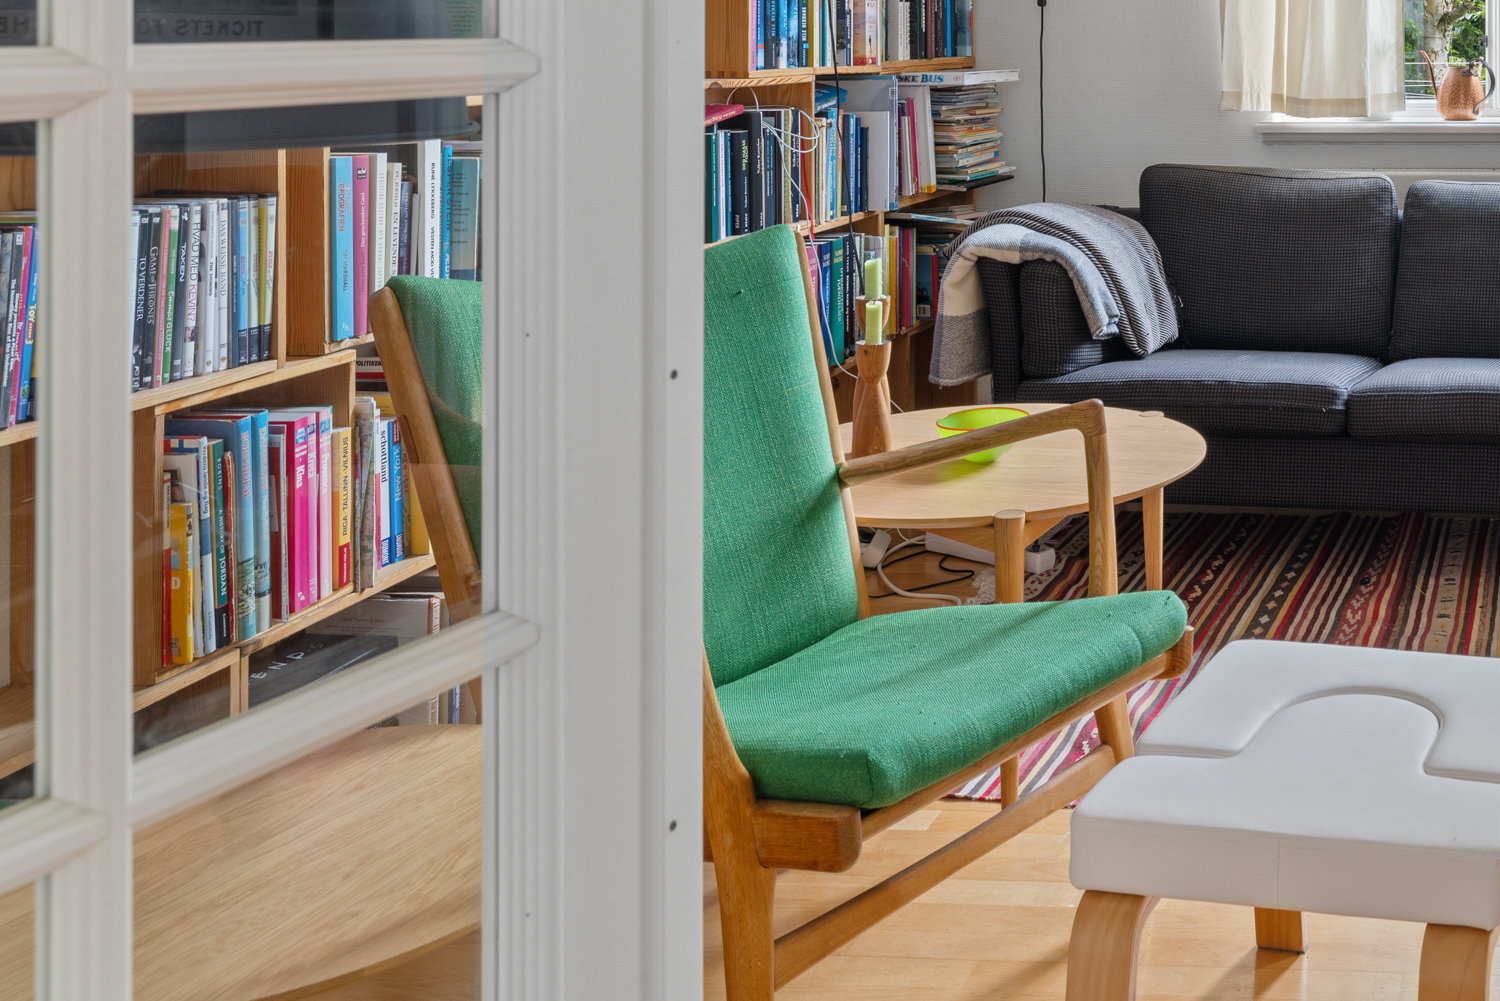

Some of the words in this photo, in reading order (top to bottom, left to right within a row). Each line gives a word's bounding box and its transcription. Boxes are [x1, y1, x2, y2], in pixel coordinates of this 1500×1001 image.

[921, 73, 944, 83] BUS
[392, 211, 398, 224] EN
[192, 221, 201, 253] HVAD
[139, 256, 147, 271] TO
[149, 246, 158, 276] GAME
[179, 242, 187, 282] TAKEN
[191, 256, 200, 281] MED
[137, 271, 146, 321] VERDENER
[147, 283, 157, 325] THRONES
[167, 291, 176, 320] Emmas
[187, 284, 197, 322] KEVIN?
[28, 303, 37, 322] TOY
[241, 432, 250, 498] BORNHOLM
[380, 430, 389, 483] schottland
[296, 464, 305, 489] Kina
[219, 557, 228, 596] JORDAN
